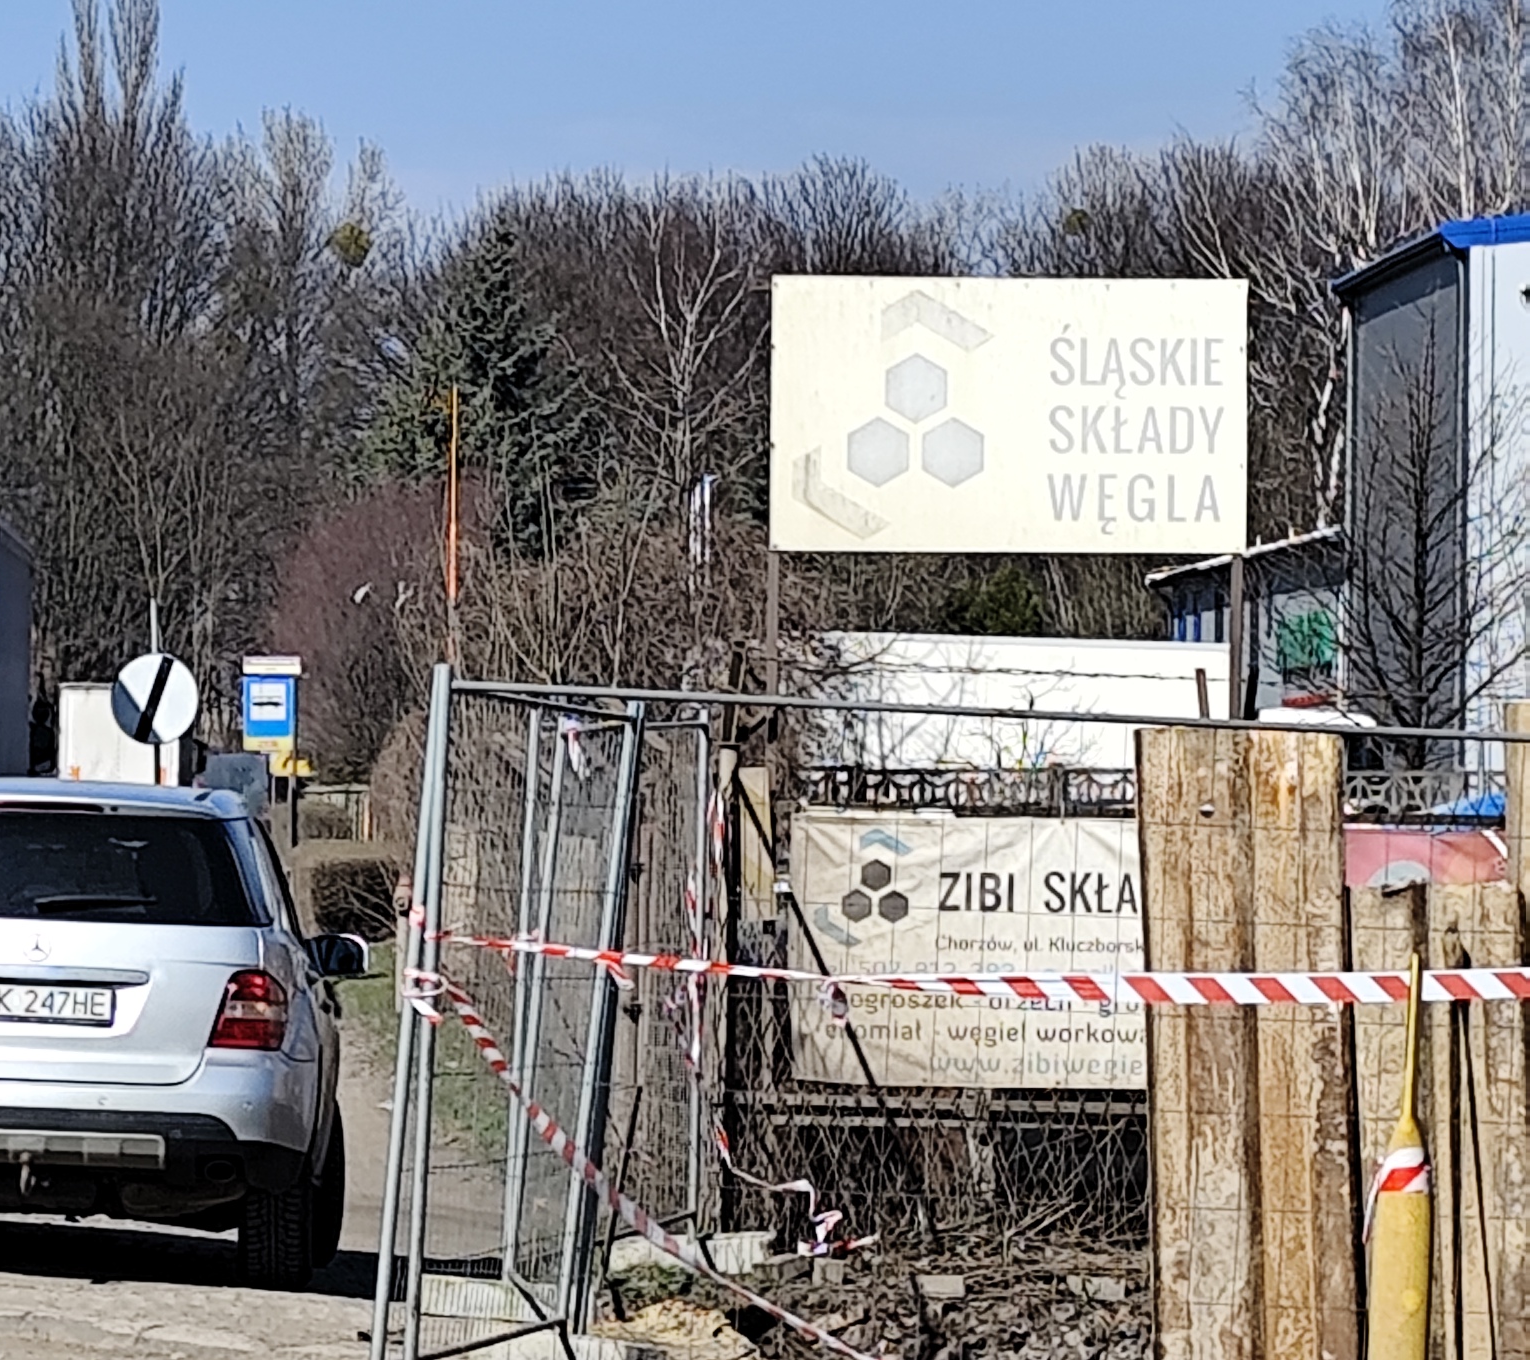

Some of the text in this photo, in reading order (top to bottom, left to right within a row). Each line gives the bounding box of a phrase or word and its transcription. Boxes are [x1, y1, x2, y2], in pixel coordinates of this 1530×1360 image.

[1048, 323, 1225, 399] ŚLĄSKIE
[1048, 404, 1225, 456] SKŁADY
[1046, 472, 1223, 536] WĘGLA
[937, 870, 1138, 914] ZIBI SKŁA
[934, 934, 1018, 955] Chorzów,
[23, 988, 107, 1017] 247HE
[947, 1020, 1027, 1048] węgiel
